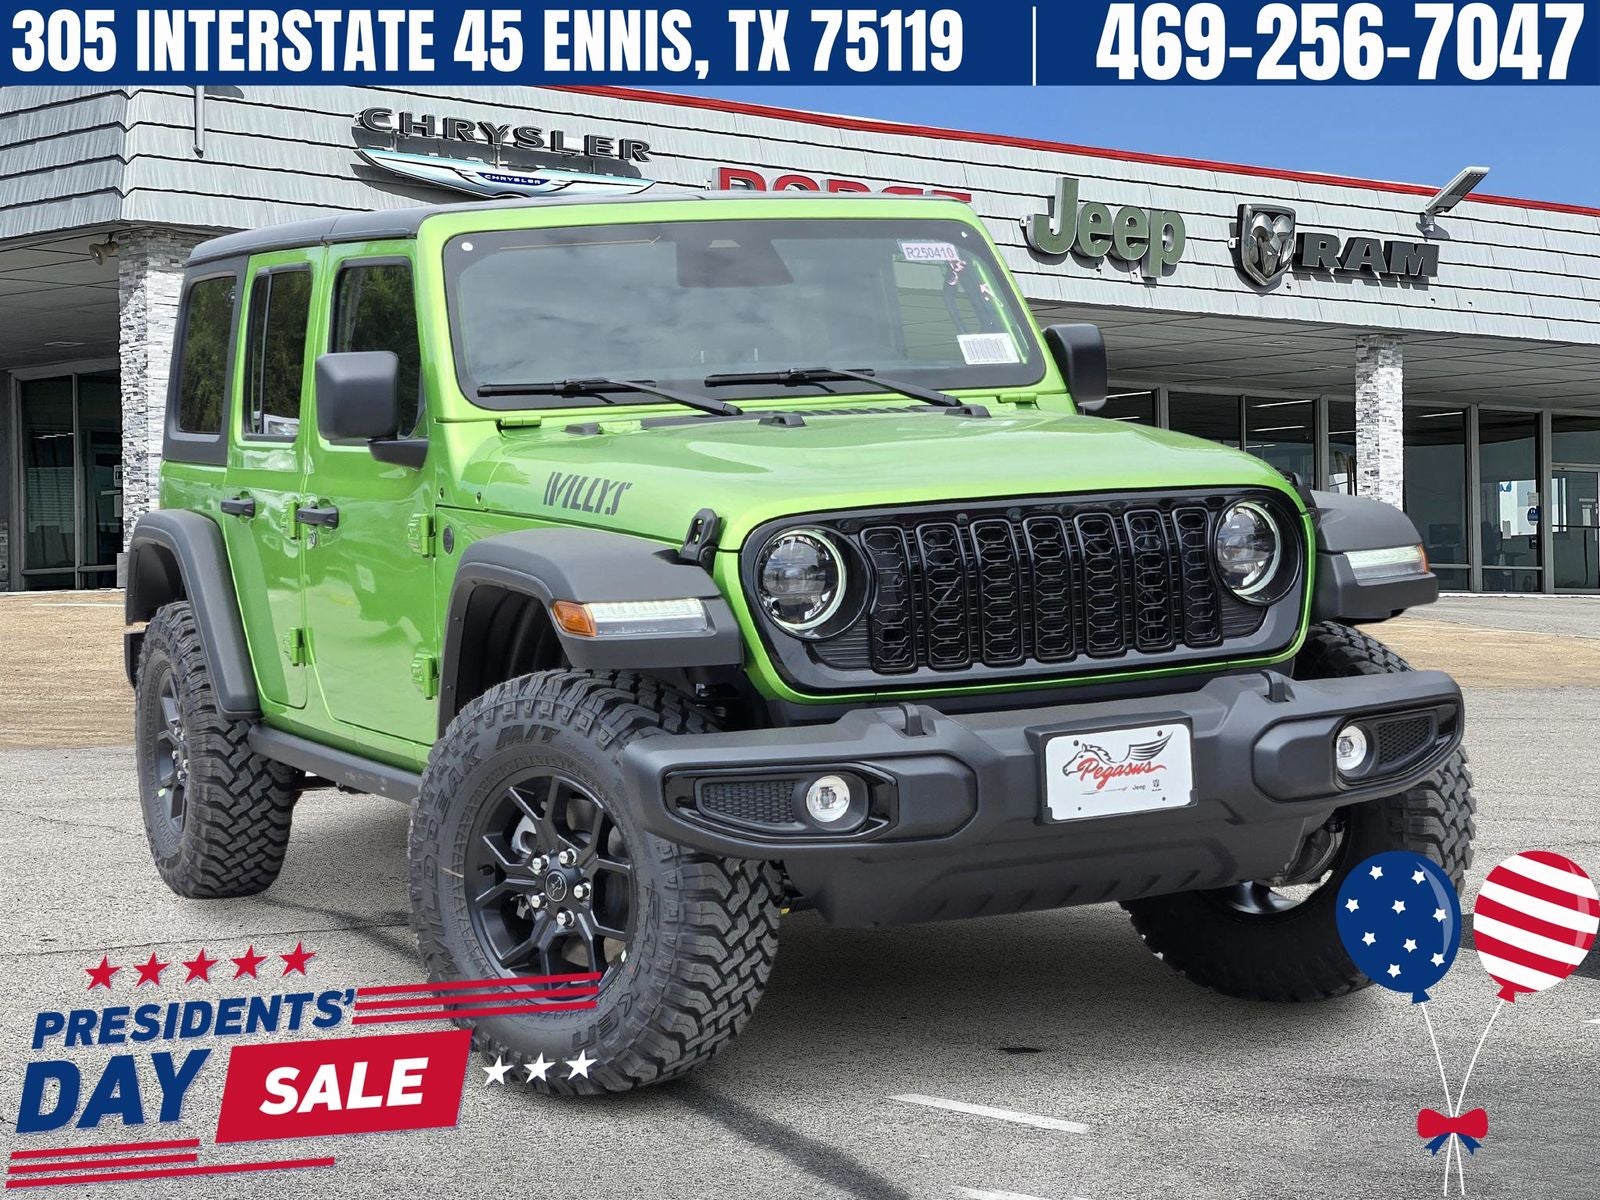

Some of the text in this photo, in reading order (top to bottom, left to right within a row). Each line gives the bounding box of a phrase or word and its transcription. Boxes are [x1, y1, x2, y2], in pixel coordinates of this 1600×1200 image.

[355, 107, 651, 162] CHRYSLER
[484, 174, 542, 185] CHRYSLER
[1026, 177, 1187, 279] Jeep
[905, 246, 956, 259] R250410
[1296, 232, 1441, 278] RAM
[543, 471, 633, 516] WILLYS
[496, 723, 561, 750] M/T
[1077, 757, 1168, 790] Pegasus
